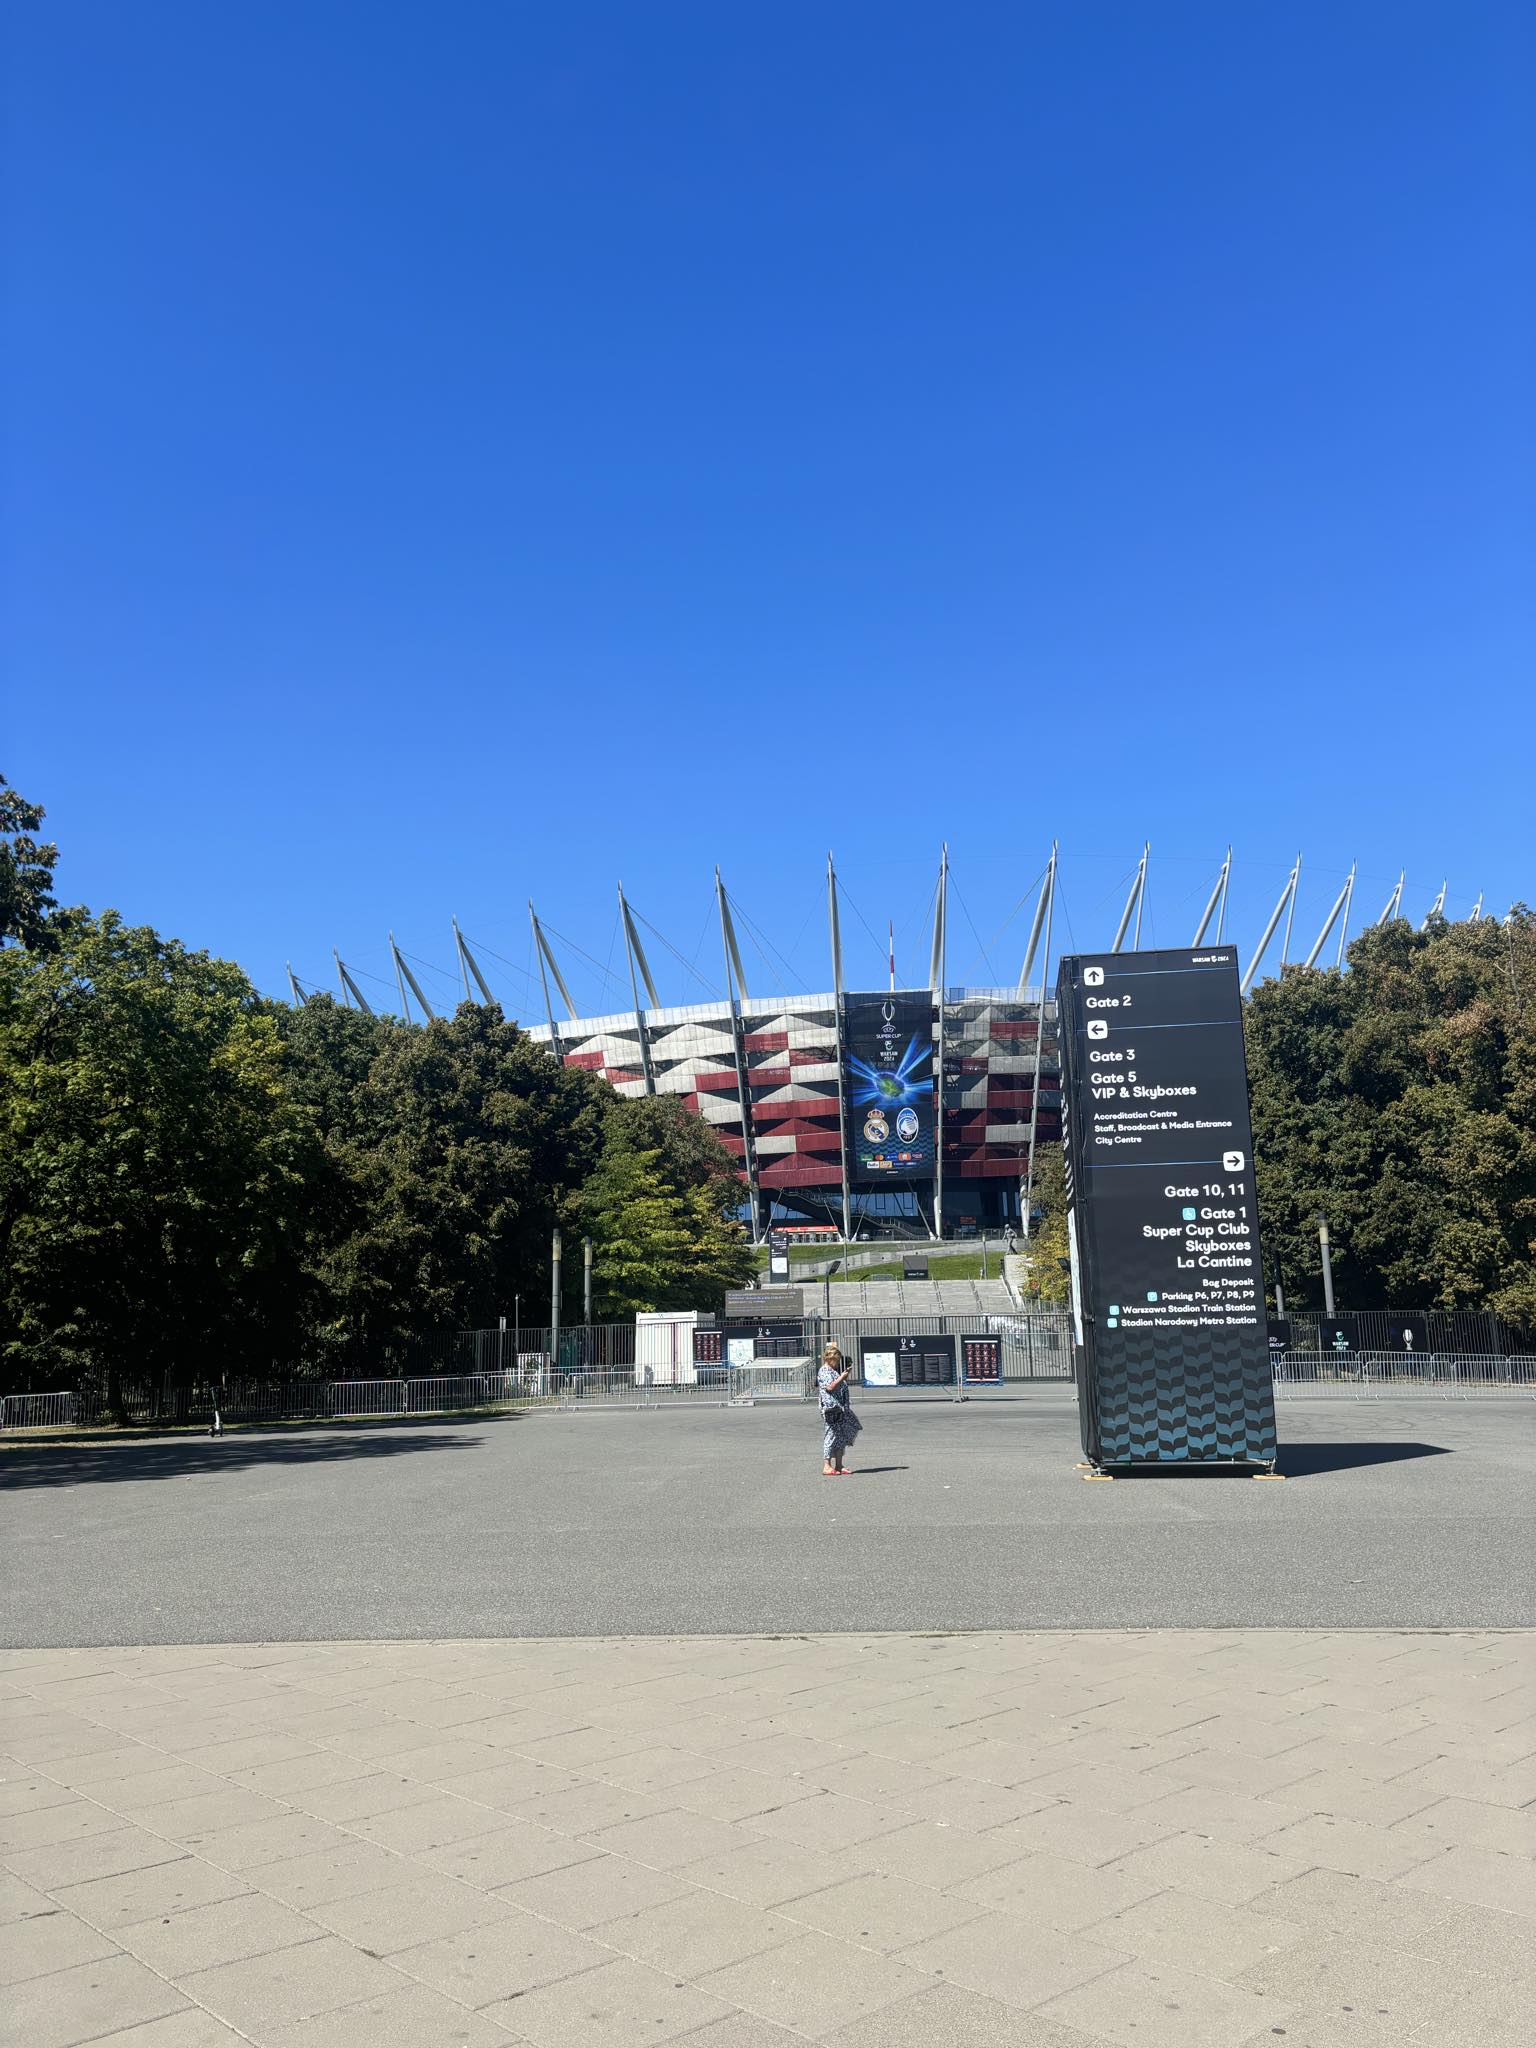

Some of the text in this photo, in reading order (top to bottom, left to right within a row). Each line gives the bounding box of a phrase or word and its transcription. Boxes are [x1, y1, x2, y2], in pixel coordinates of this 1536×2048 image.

[1086, 995, 1131, 1008] Gate 2
[1090, 1049, 1135, 1062] Gate 3
[1091, 1071, 1136, 1084] Gate 5
[1092, 1085, 1196, 1099] VIP & Skyboxes
[1094, 1112, 1148, 1120] Accreditation
[1095, 1124, 1116, 1132] Staff,
[1118, 1123, 1159, 1131] Broadcast
[1169, 1121, 1194, 1129] Media
[1095, 1137, 1113, 1145] City
[1165, 1184, 1244, 1198] Gate 10, 11
[1201, 1206, 1247, 1219] Gate 1
[1143, 1223, 1249, 1239] Super Cup Club
[1185, 1240, 1252, 1254] Skyboxes
[1177, 1255, 1252, 1268] La Cantine
[1203, 1278, 1254, 1288] Bag Deposit
[1162, 1290, 1254, 1301] Parking P6, P7, P8, P9
[1202, 1304, 1224, 1312] Train
[1226, 1304, 1256, 1312] Station
[1155, 1318, 1198, 1326] Narodowy
[1226, 1316, 1256, 1324] Station
